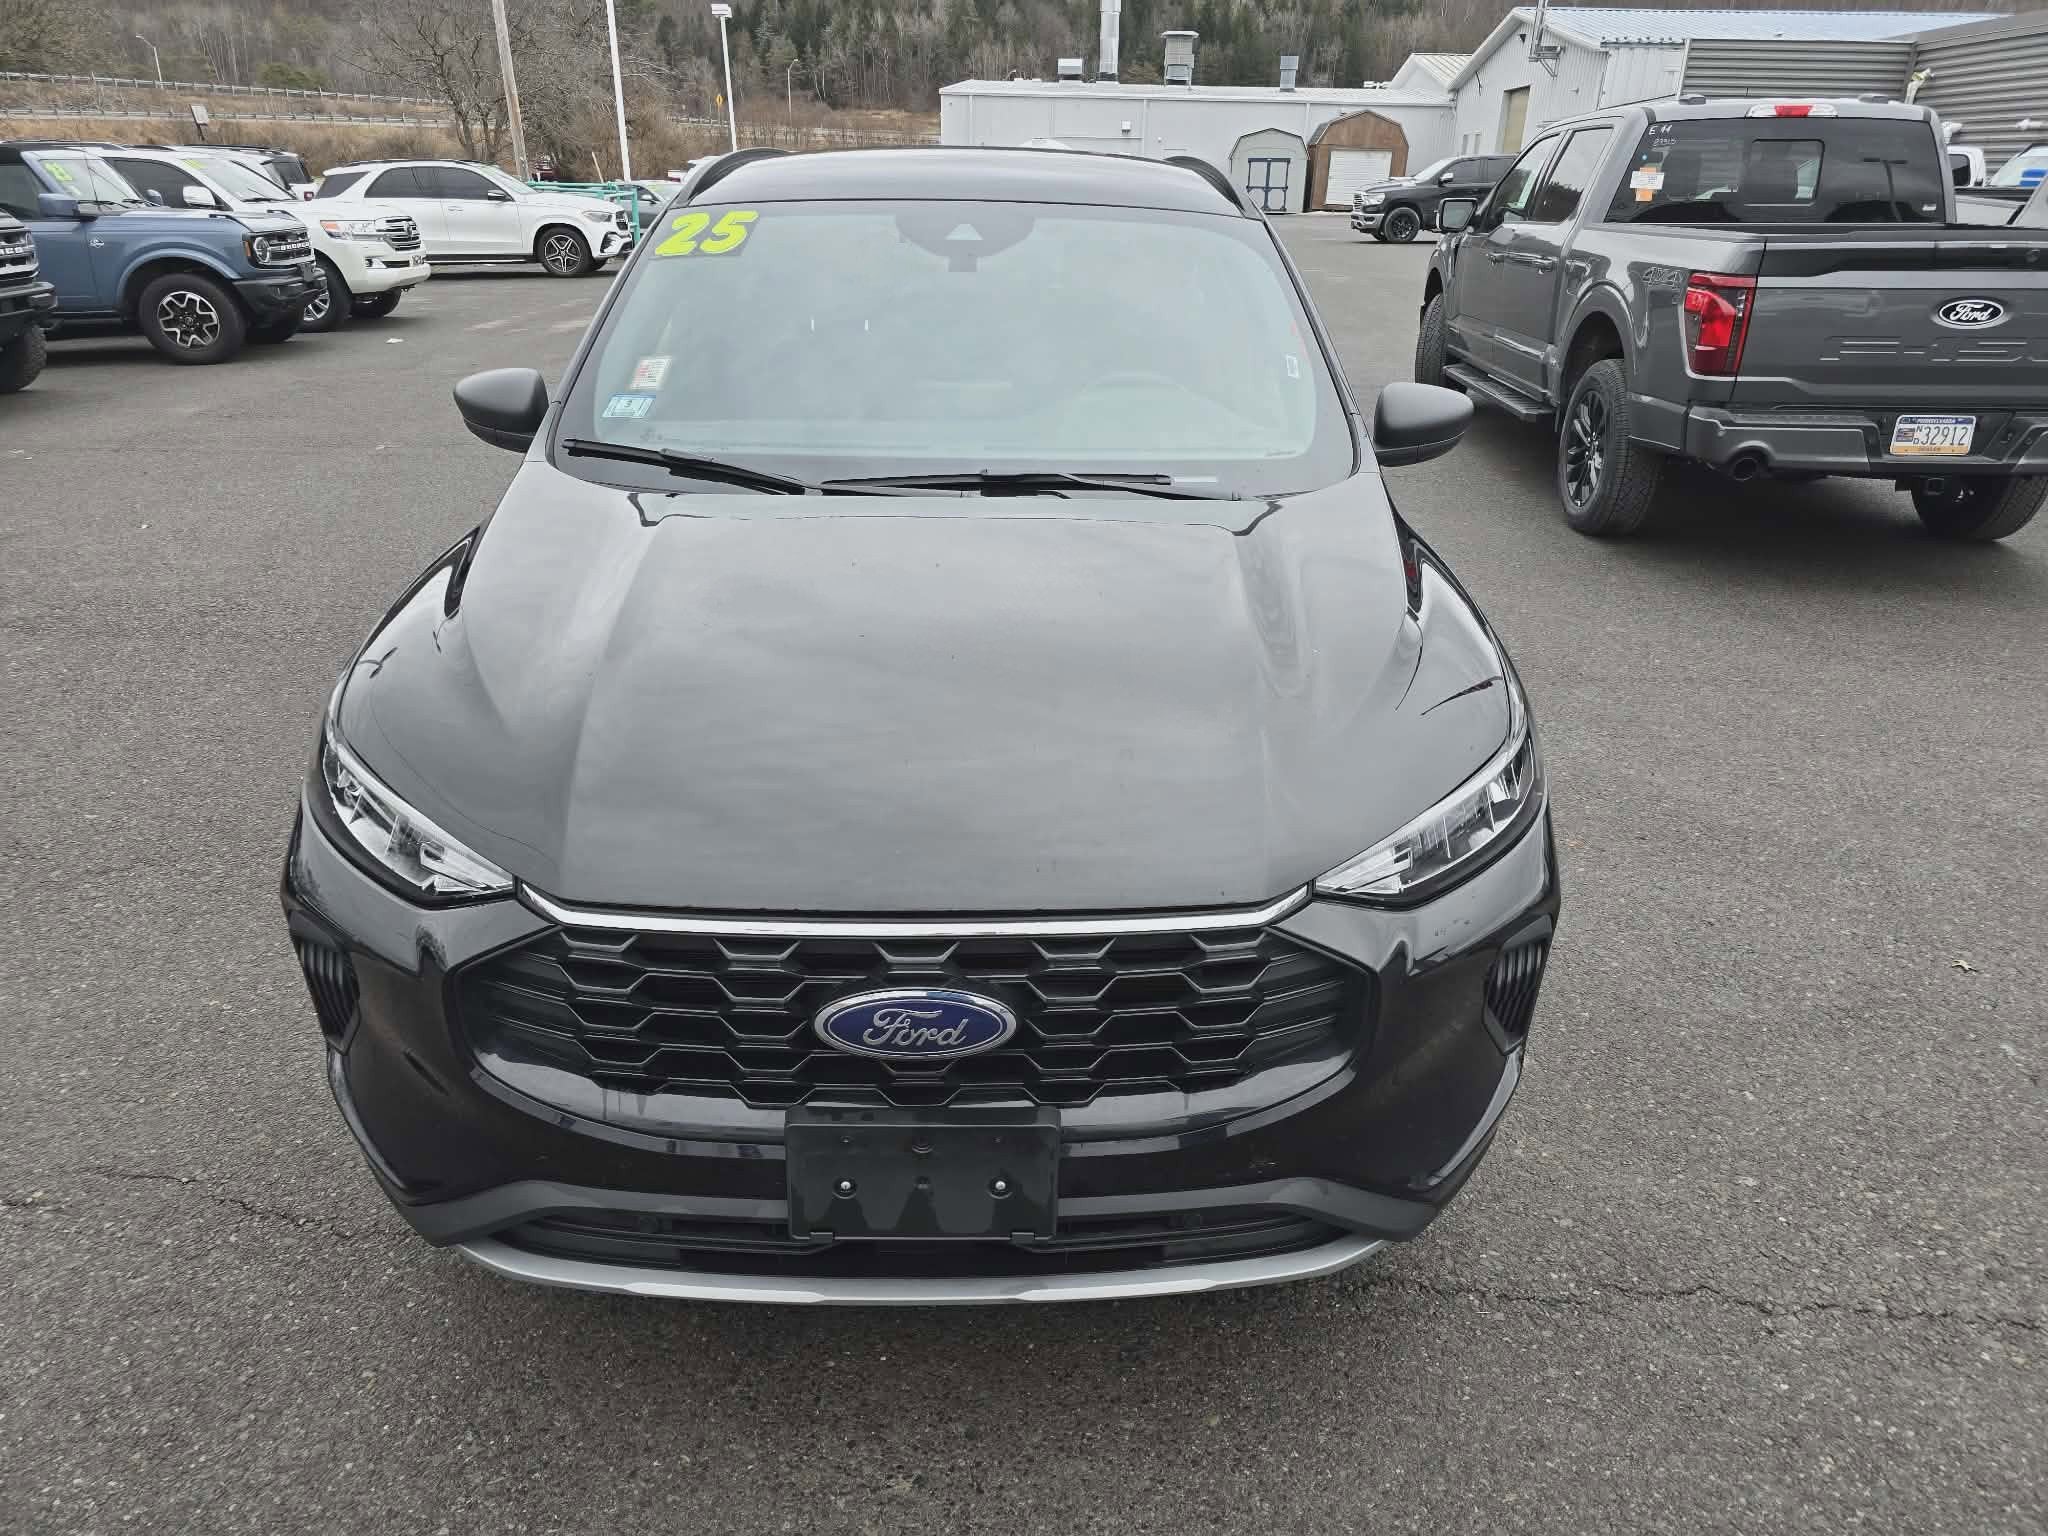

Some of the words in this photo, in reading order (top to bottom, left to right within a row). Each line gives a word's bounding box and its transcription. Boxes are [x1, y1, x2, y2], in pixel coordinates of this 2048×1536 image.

[655, 210, 760, 257] 25
[1949, 303, 1994, 321] Ford
[862, 1008, 969, 1046] Ford
